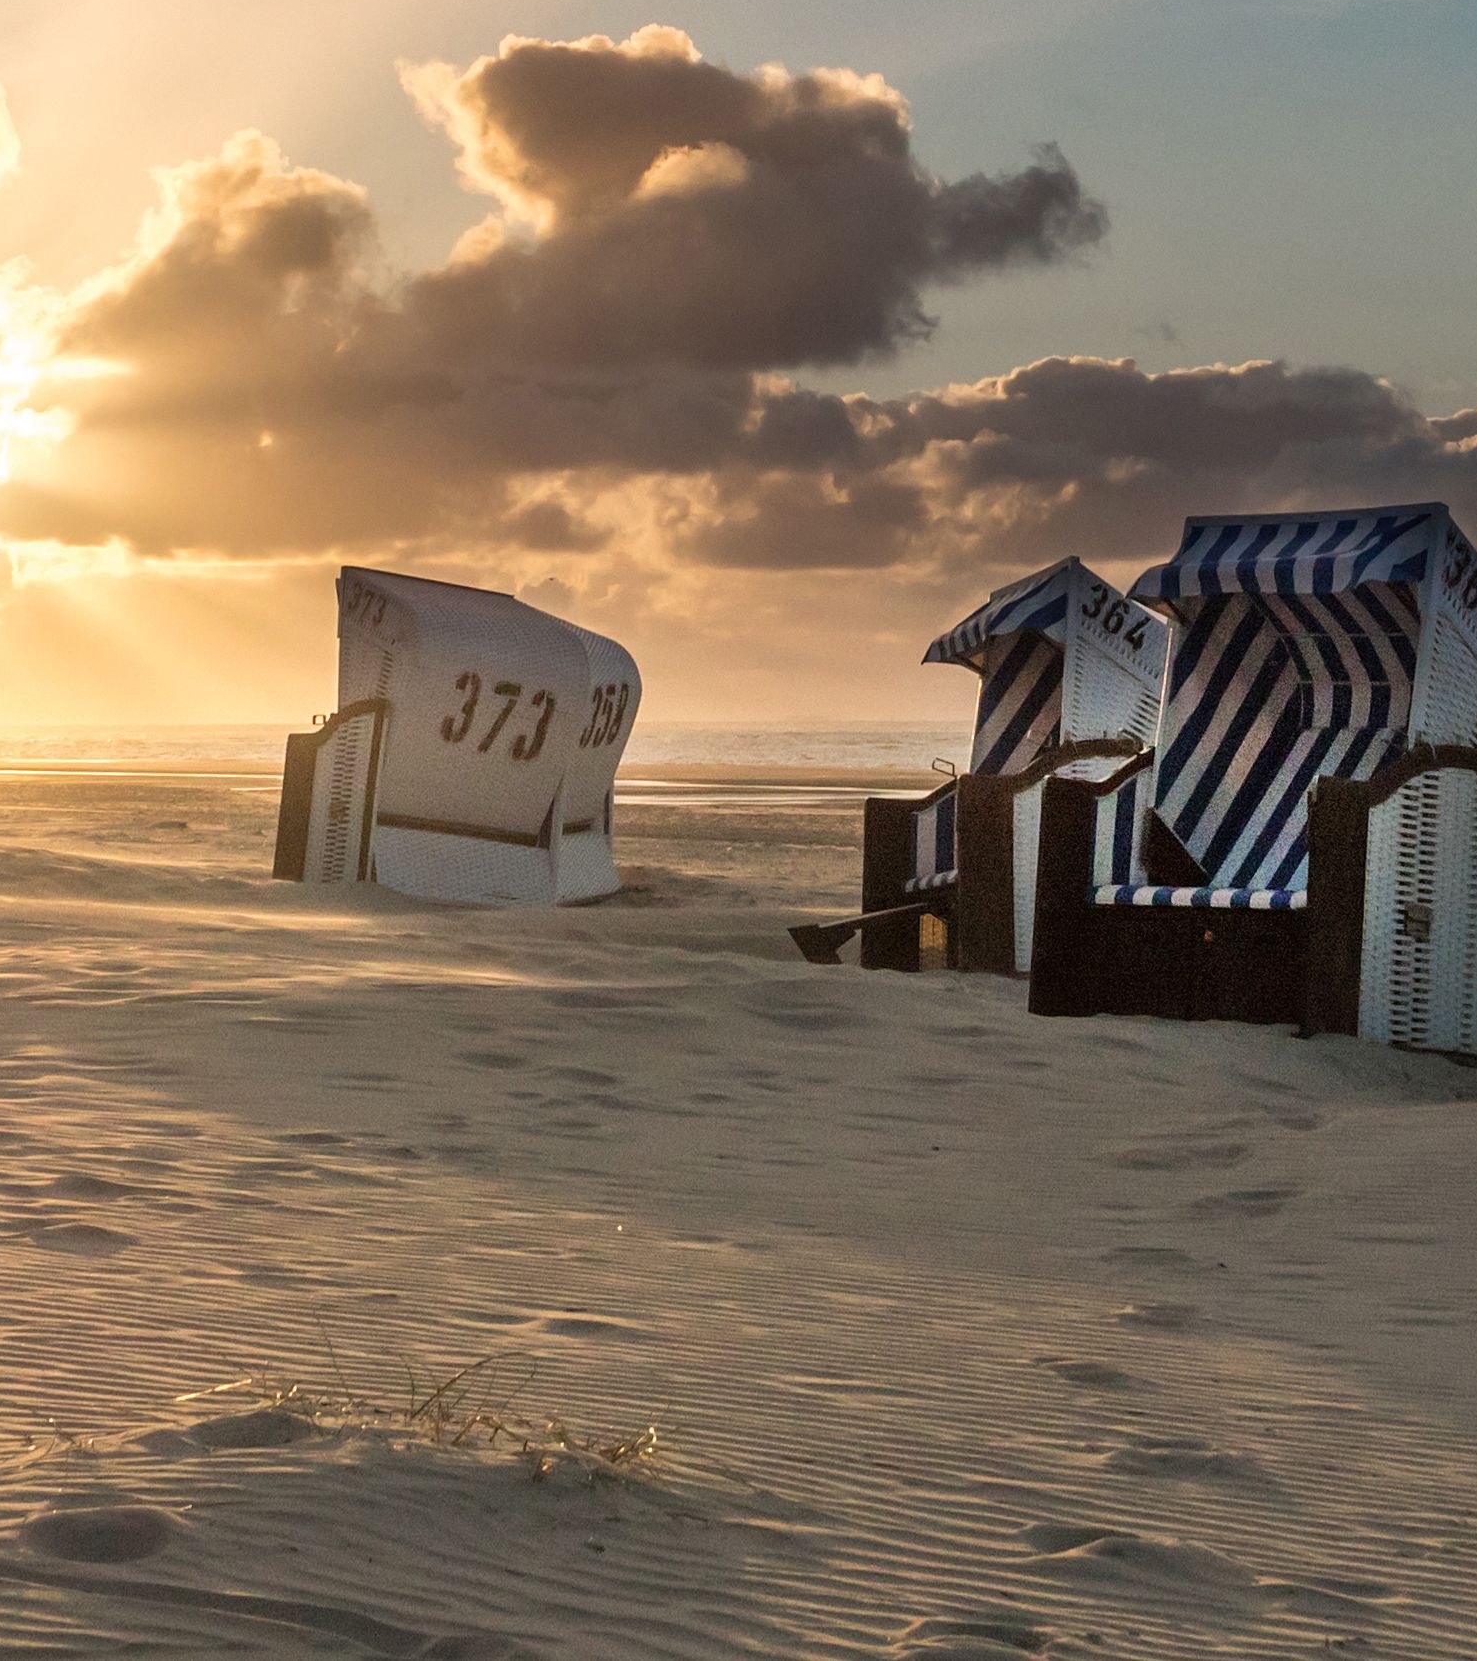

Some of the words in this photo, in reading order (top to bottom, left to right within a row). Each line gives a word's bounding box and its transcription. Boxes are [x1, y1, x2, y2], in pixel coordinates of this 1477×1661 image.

[347, 582, 387, 627] 373
[1082, 584, 1151, 651] 364
[441, 671, 557, 760] 373
[579, 683, 629, 749] 358
